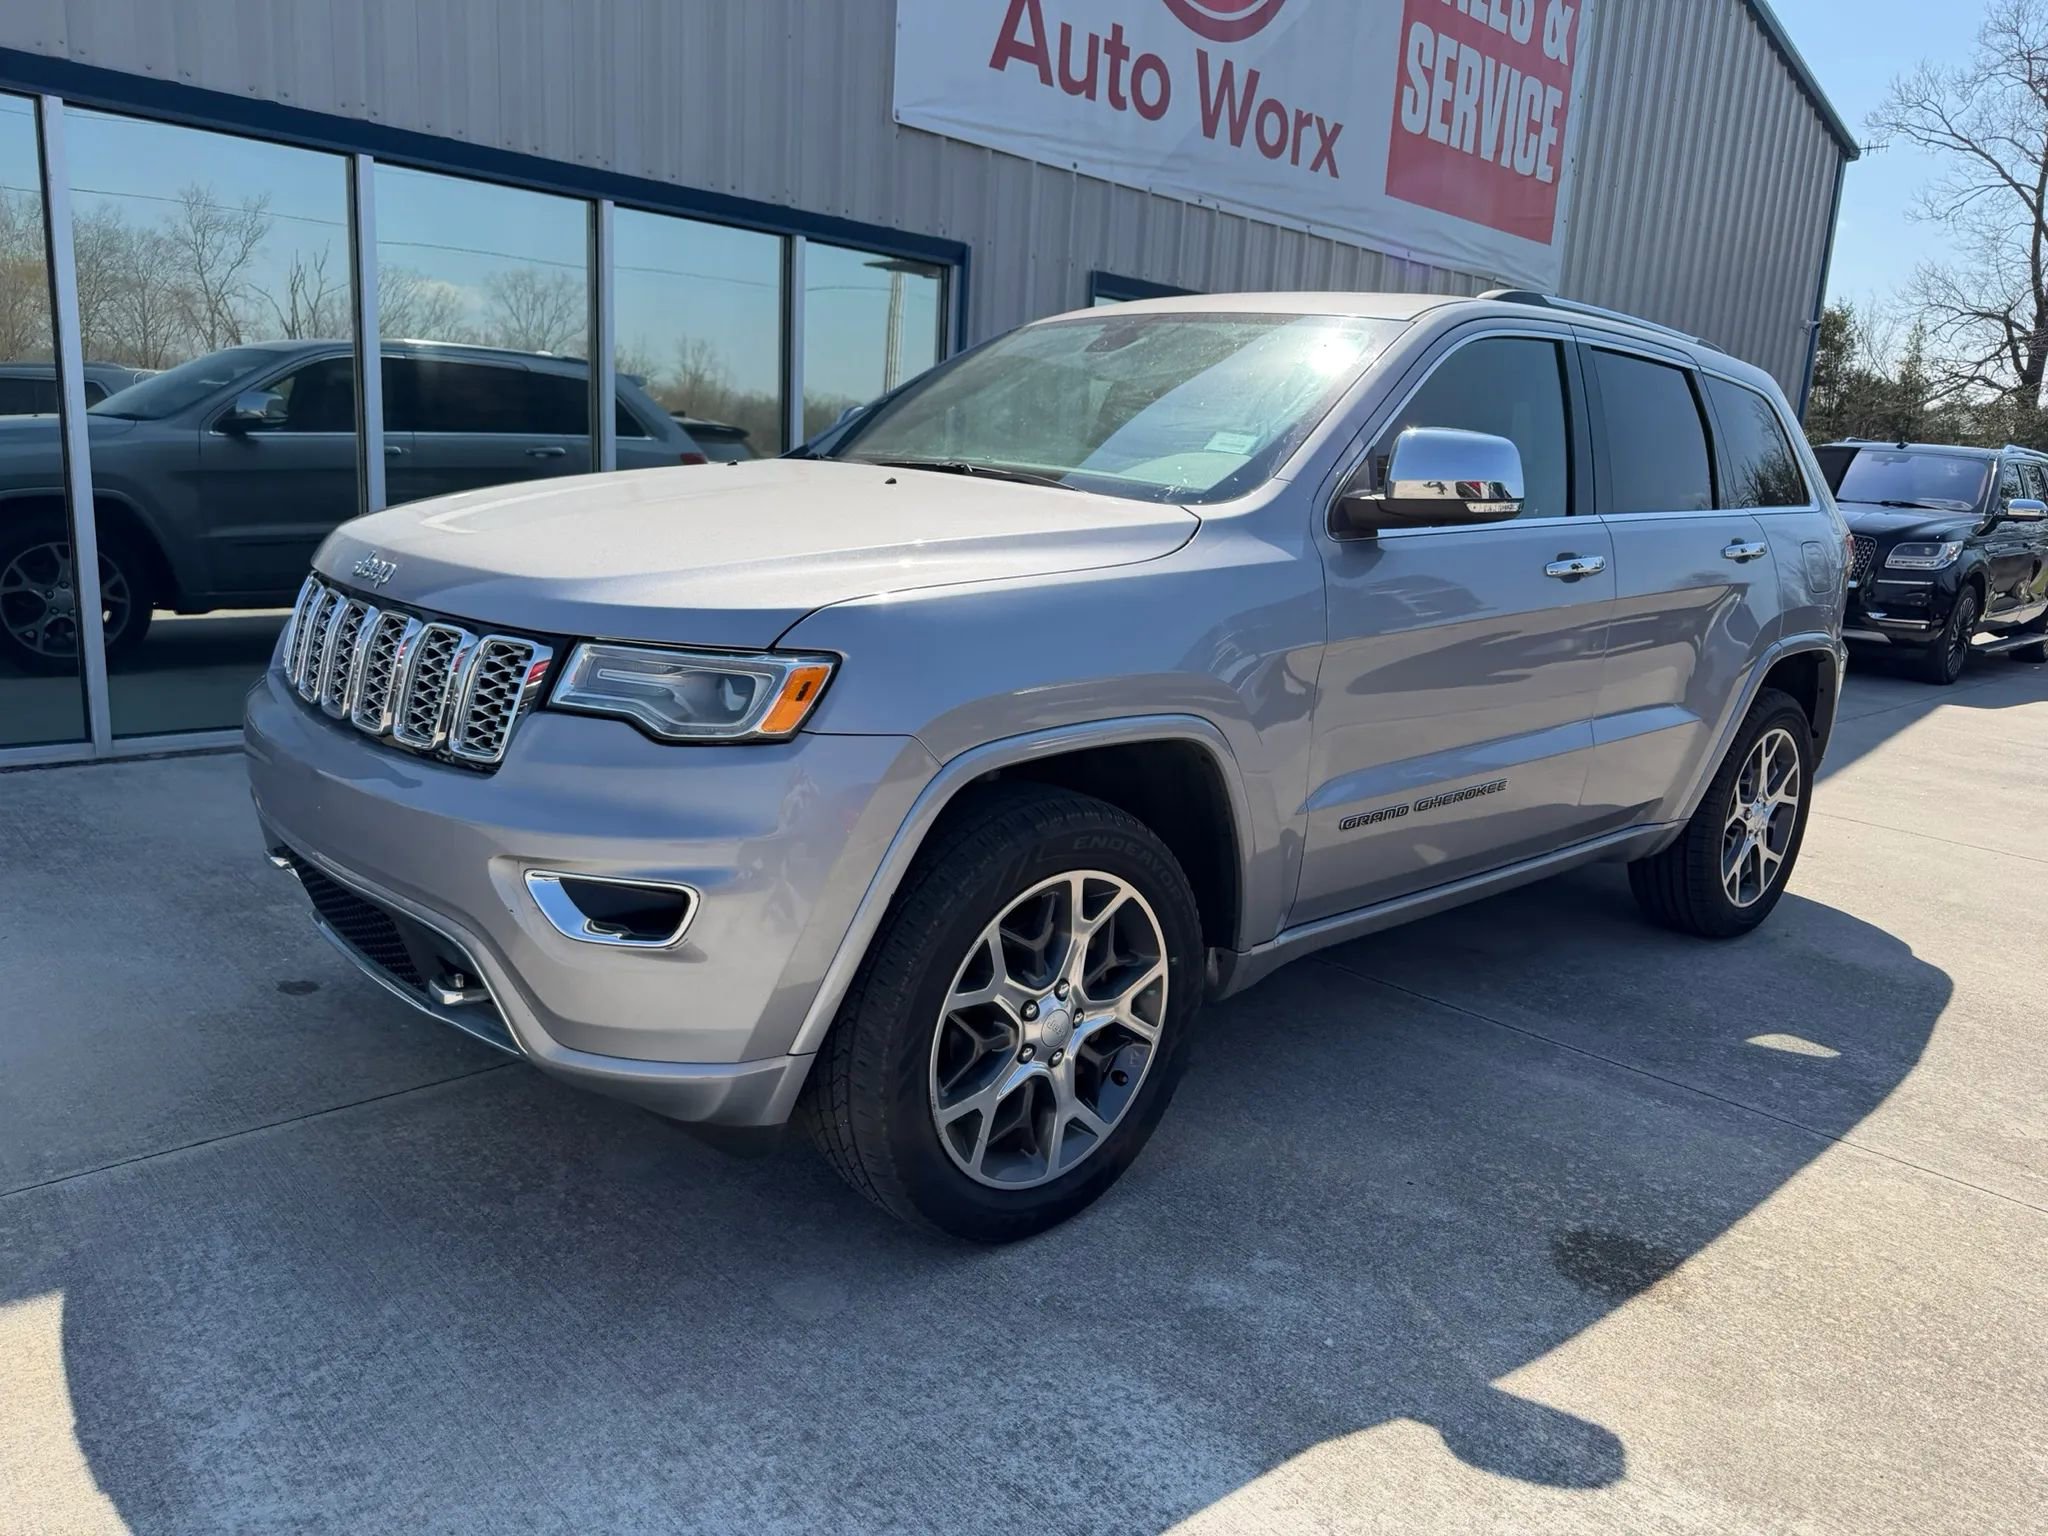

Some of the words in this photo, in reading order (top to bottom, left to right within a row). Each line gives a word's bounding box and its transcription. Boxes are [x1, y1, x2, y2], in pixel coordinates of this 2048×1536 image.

[989, 0, 1171, 121] Auto
[1196, 48, 1344, 179] Worx
[1401, 21, 1563, 183] SERVICE
[352, 550, 397, 589] Jeep
[1339, 803, 1410, 831] GRAND
[1413, 778, 1510, 811] CHEROKEE
[1074, 835, 1183, 898] ENDEAVOR
